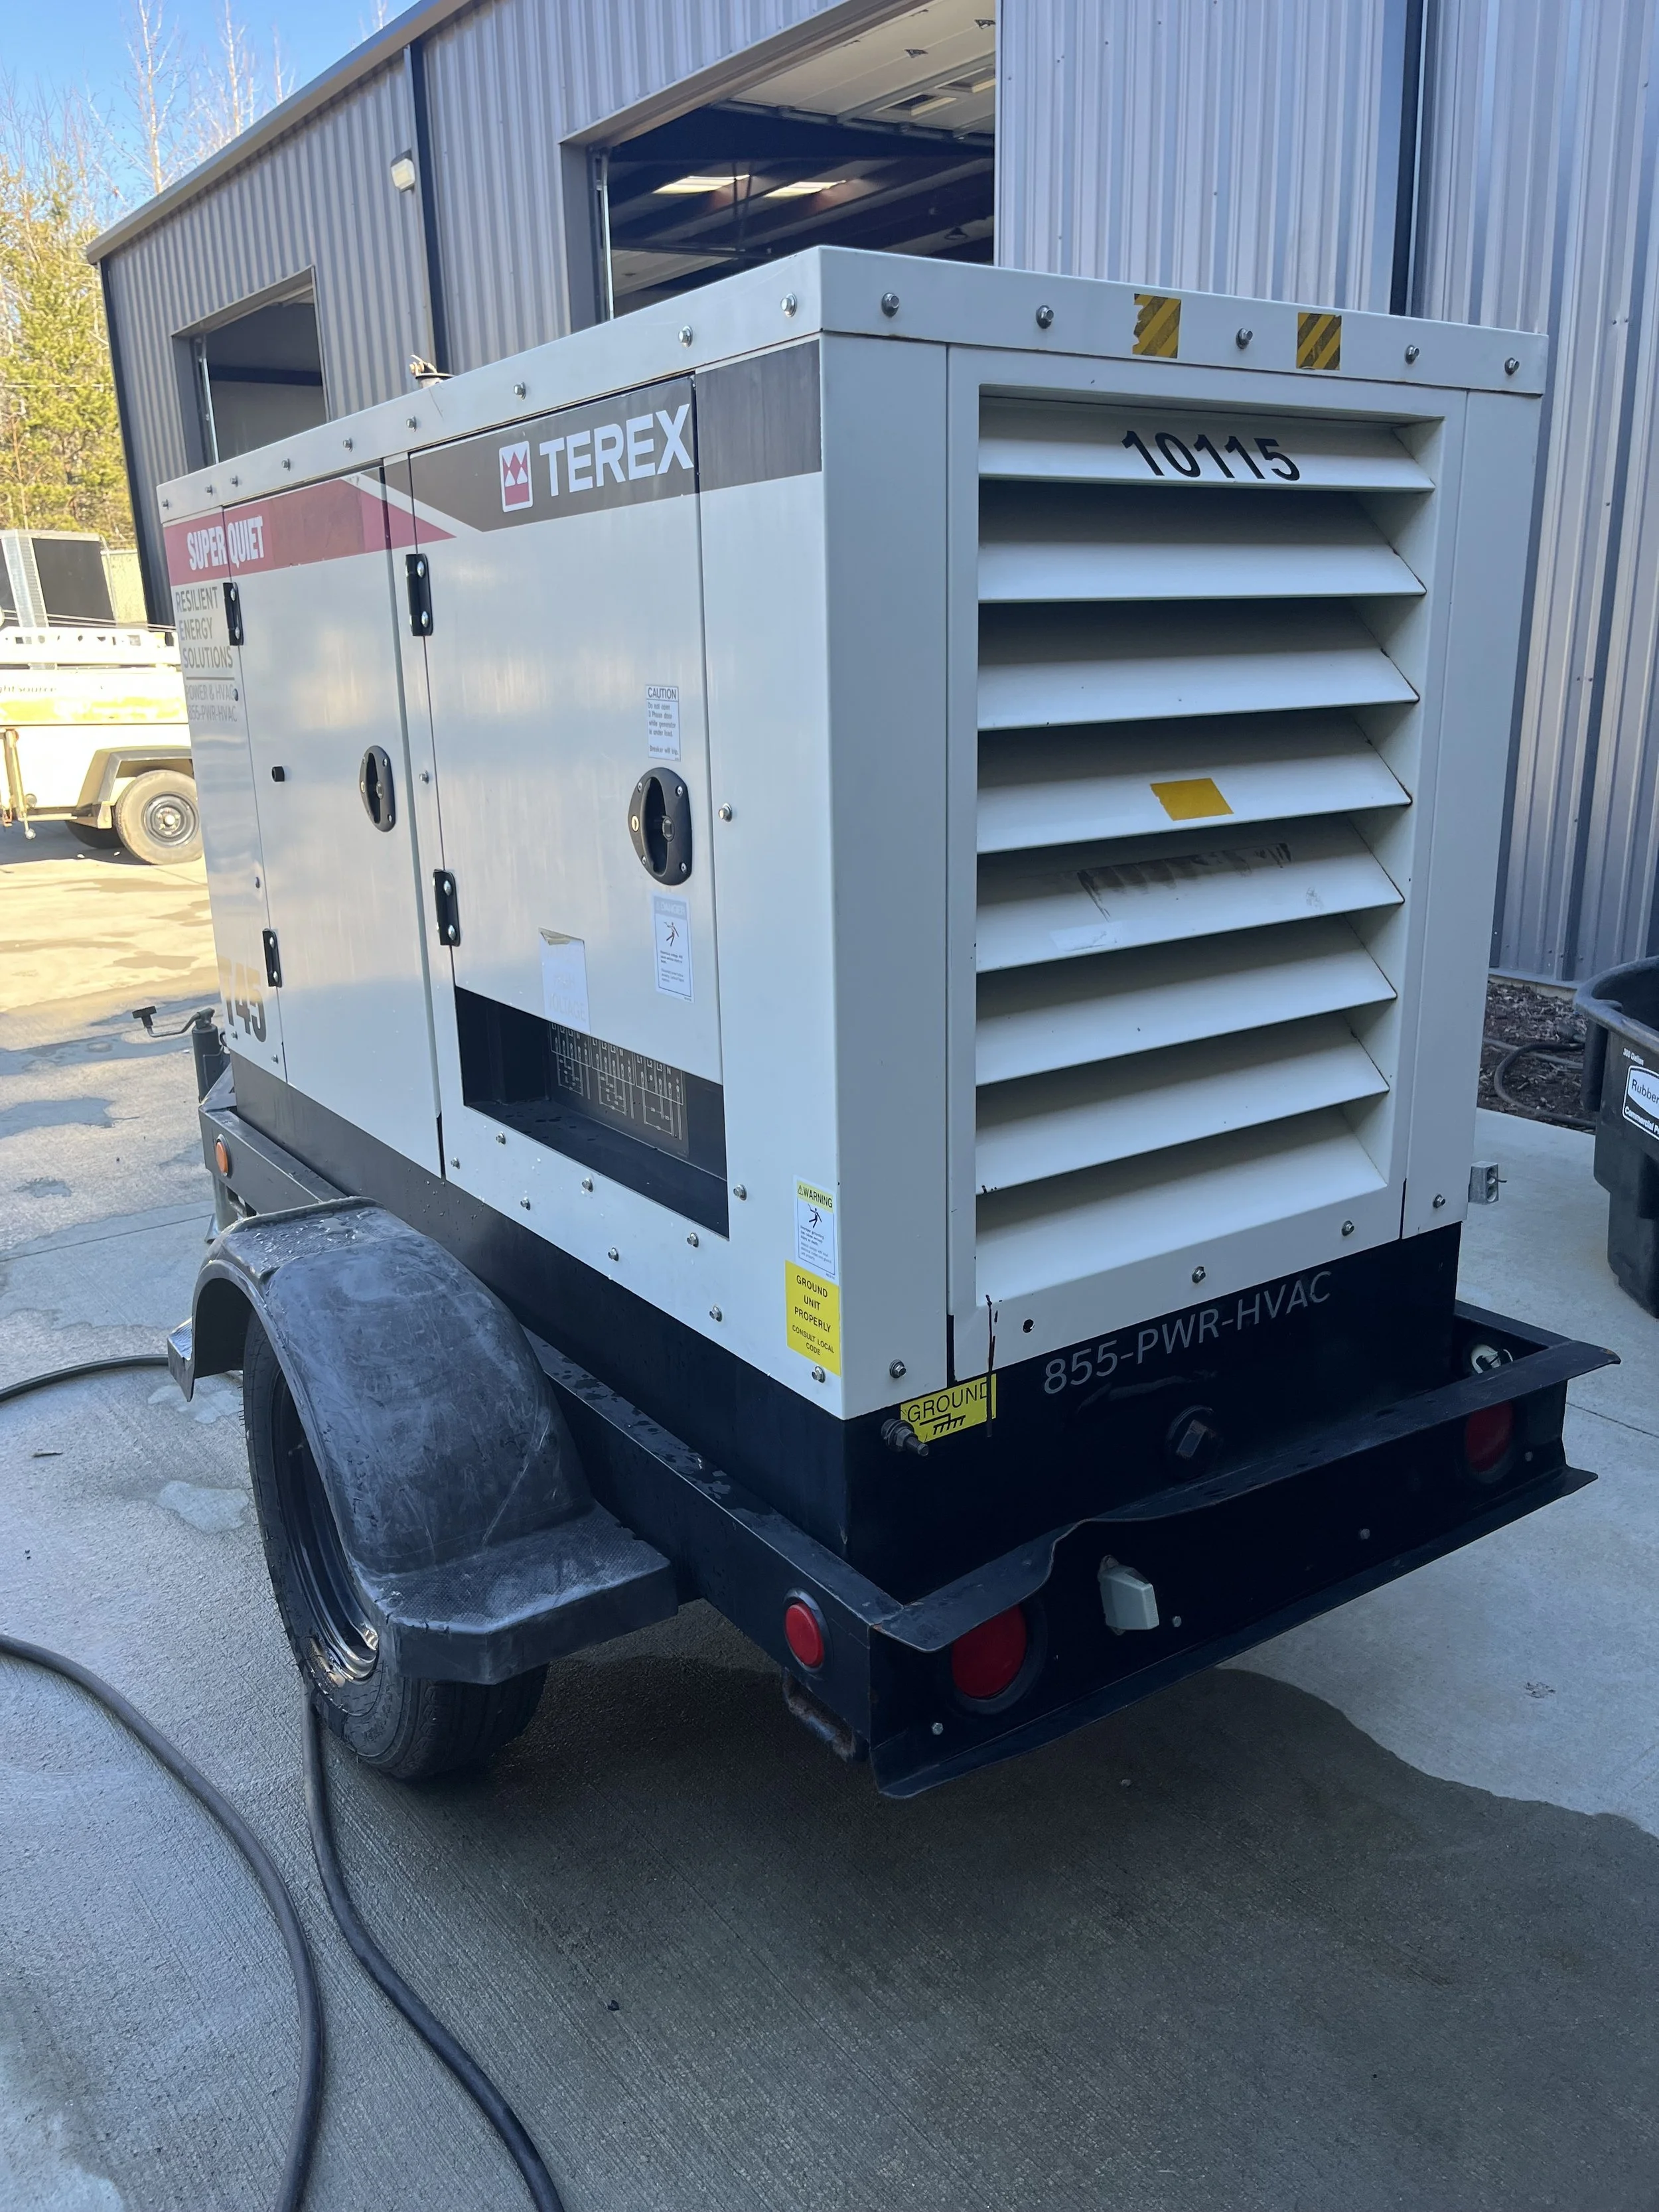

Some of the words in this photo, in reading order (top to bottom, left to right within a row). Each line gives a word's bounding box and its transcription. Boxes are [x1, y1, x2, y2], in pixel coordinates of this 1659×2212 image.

[539, 403, 694, 497] TEREX
[1121, 430, 1301, 481] 10115
[186, 526, 228, 571] SUPER
[228, 515, 264, 569] QUIET
[175, 586, 218, 613] RESILIENT
[179, 617, 213, 641] ENERGY
[182, 646, 234, 669] SOLUTIONS
[185, 684, 208, 701] POWER
[648, 687, 677, 700] CAUTION
[188, 704, 238, 722] 855-PWR-HVAC
[1624, 1106, 1654, 1131] Commercial
[802, 1186, 833, 1208] WARNING
[796, 1275, 828, 1298] GROUND
[804, 1295, 821, 1311] UNIT
[794, 1306, 831, 1333] PROPERLY
[792, 1324, 816, 1343] CONSULT
[817, 1338, 835, 1354] LOCAL
[1043, 1270, 1333, 1394] 855-PWR-HVAC
[806, 1342, 822, 1356] CODE
